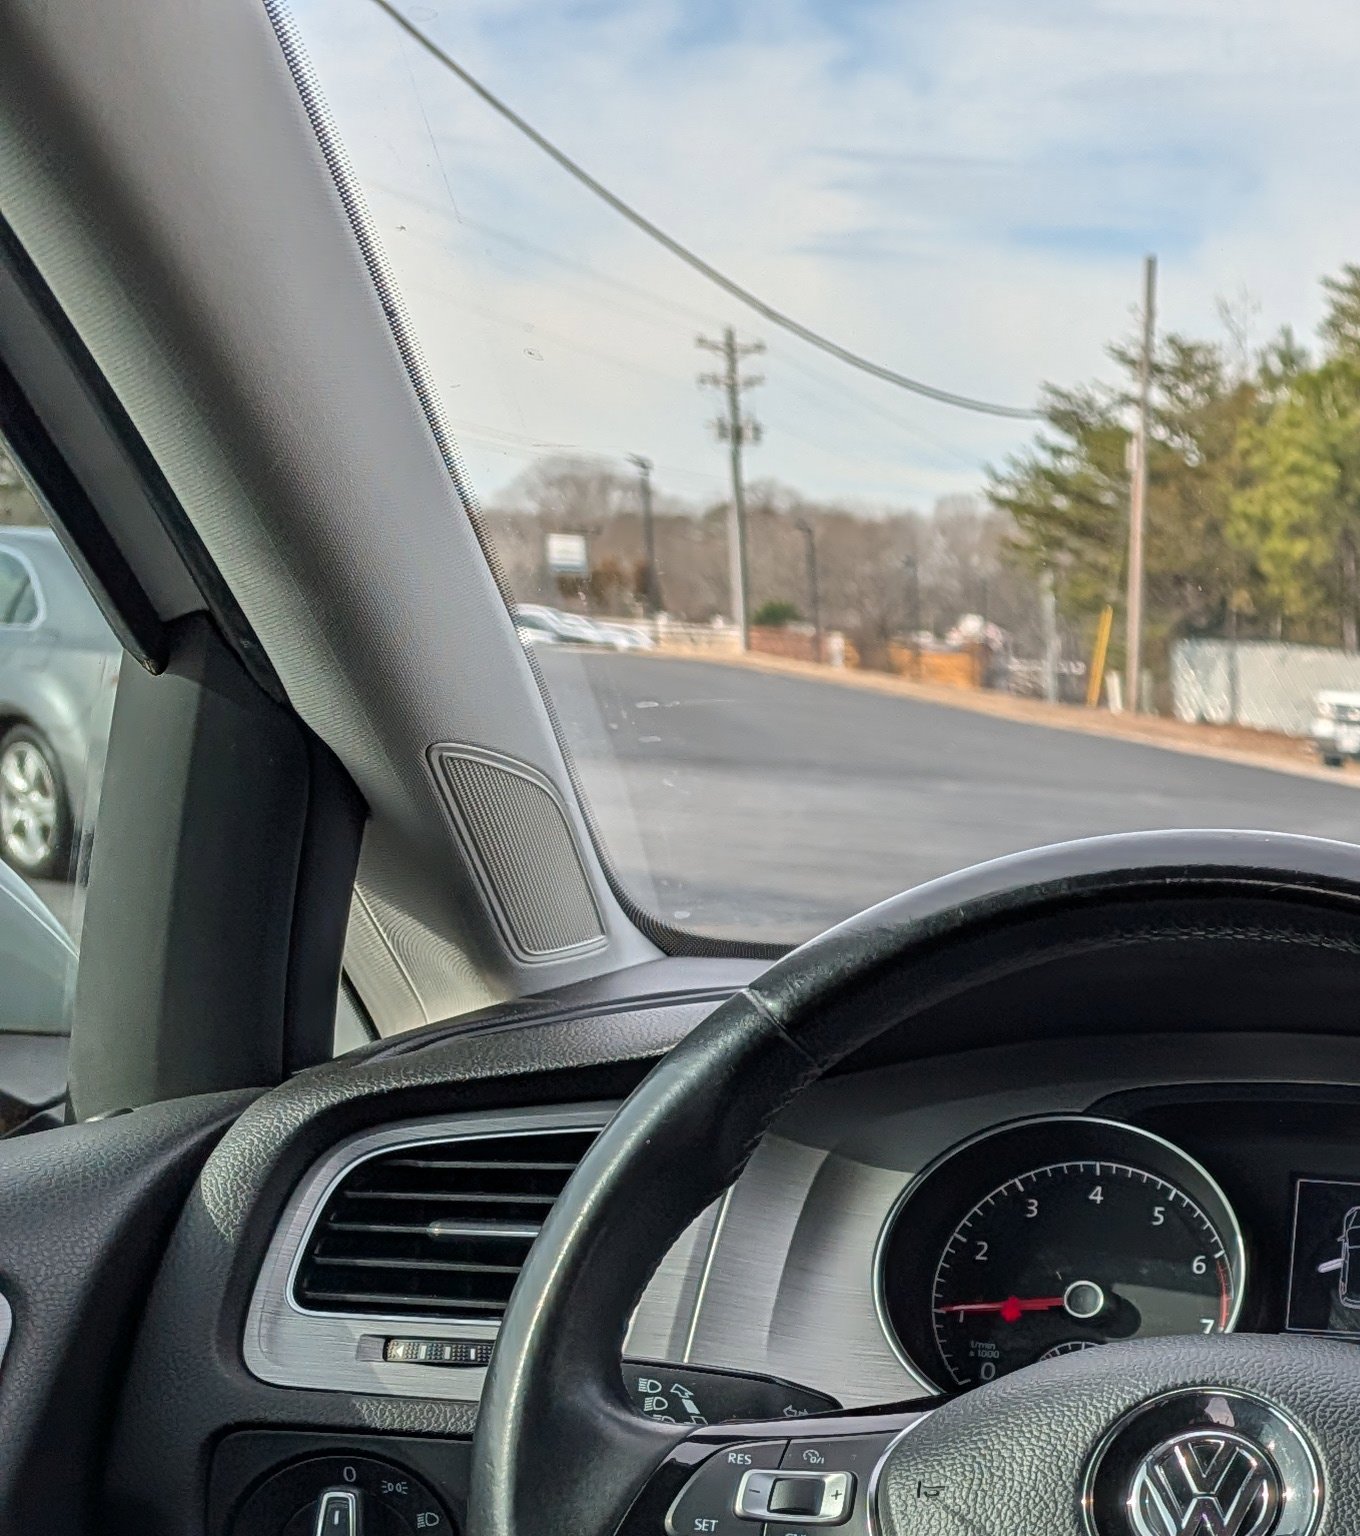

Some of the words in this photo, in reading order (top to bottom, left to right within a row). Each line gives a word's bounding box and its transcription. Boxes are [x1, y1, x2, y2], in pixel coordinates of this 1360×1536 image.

[1088, 1186, 1104, 1204] 4
[1025, 1199, 1038, 1218] 3
[1152, 1206, 1166, 1226] 5
[975, 1241, 988, 1261] 2
[1192, 1255, 1207, 1274] 6
[1200, 1319, 1215, 1334] 7
[980, 1362, 996, 1380] 0
[727, 1452, 752, 1465] RES
[694, 1518, 719, 1532] SET
